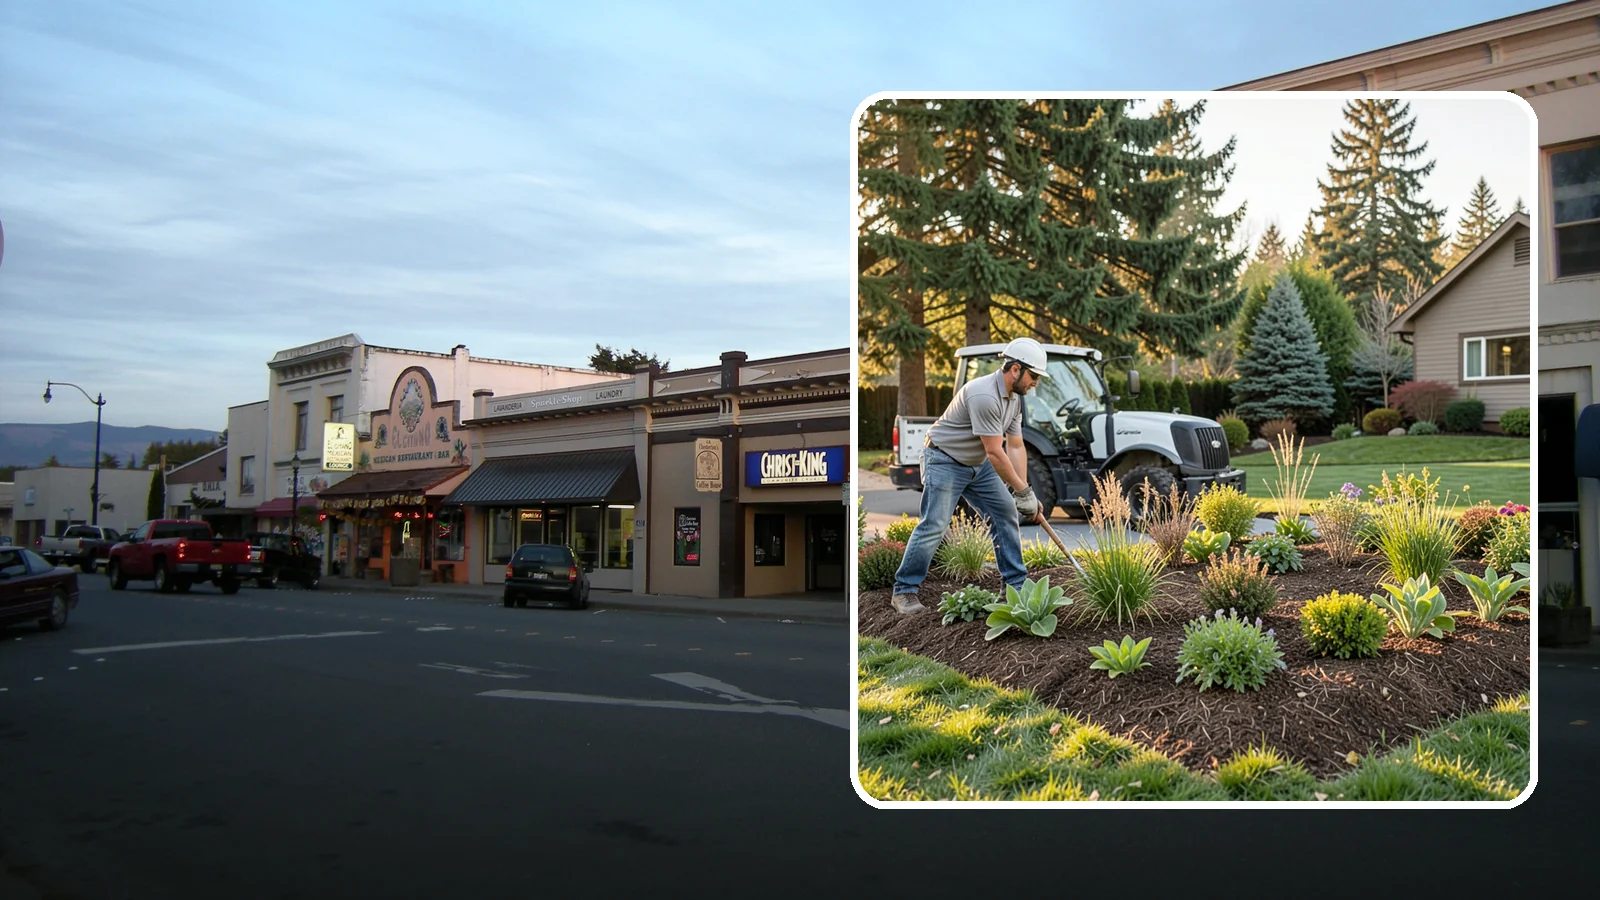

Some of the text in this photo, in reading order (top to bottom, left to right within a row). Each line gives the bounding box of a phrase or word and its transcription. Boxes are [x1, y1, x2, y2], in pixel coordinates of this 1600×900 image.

[561, 394, 582, 404] Shop
[595, 389, 623, 400] LAUNDRY
[493, 402, 522, 413] LAVANDERIA
[373, 455, 396, 464] MEXICAN
[398, 451, 433, 462] RESTAURANT
[438, 450, 450, 459] BAR
[761, 450, 827, 478] CHRIST KING
[696, 481, 722, 489] Coffee House
